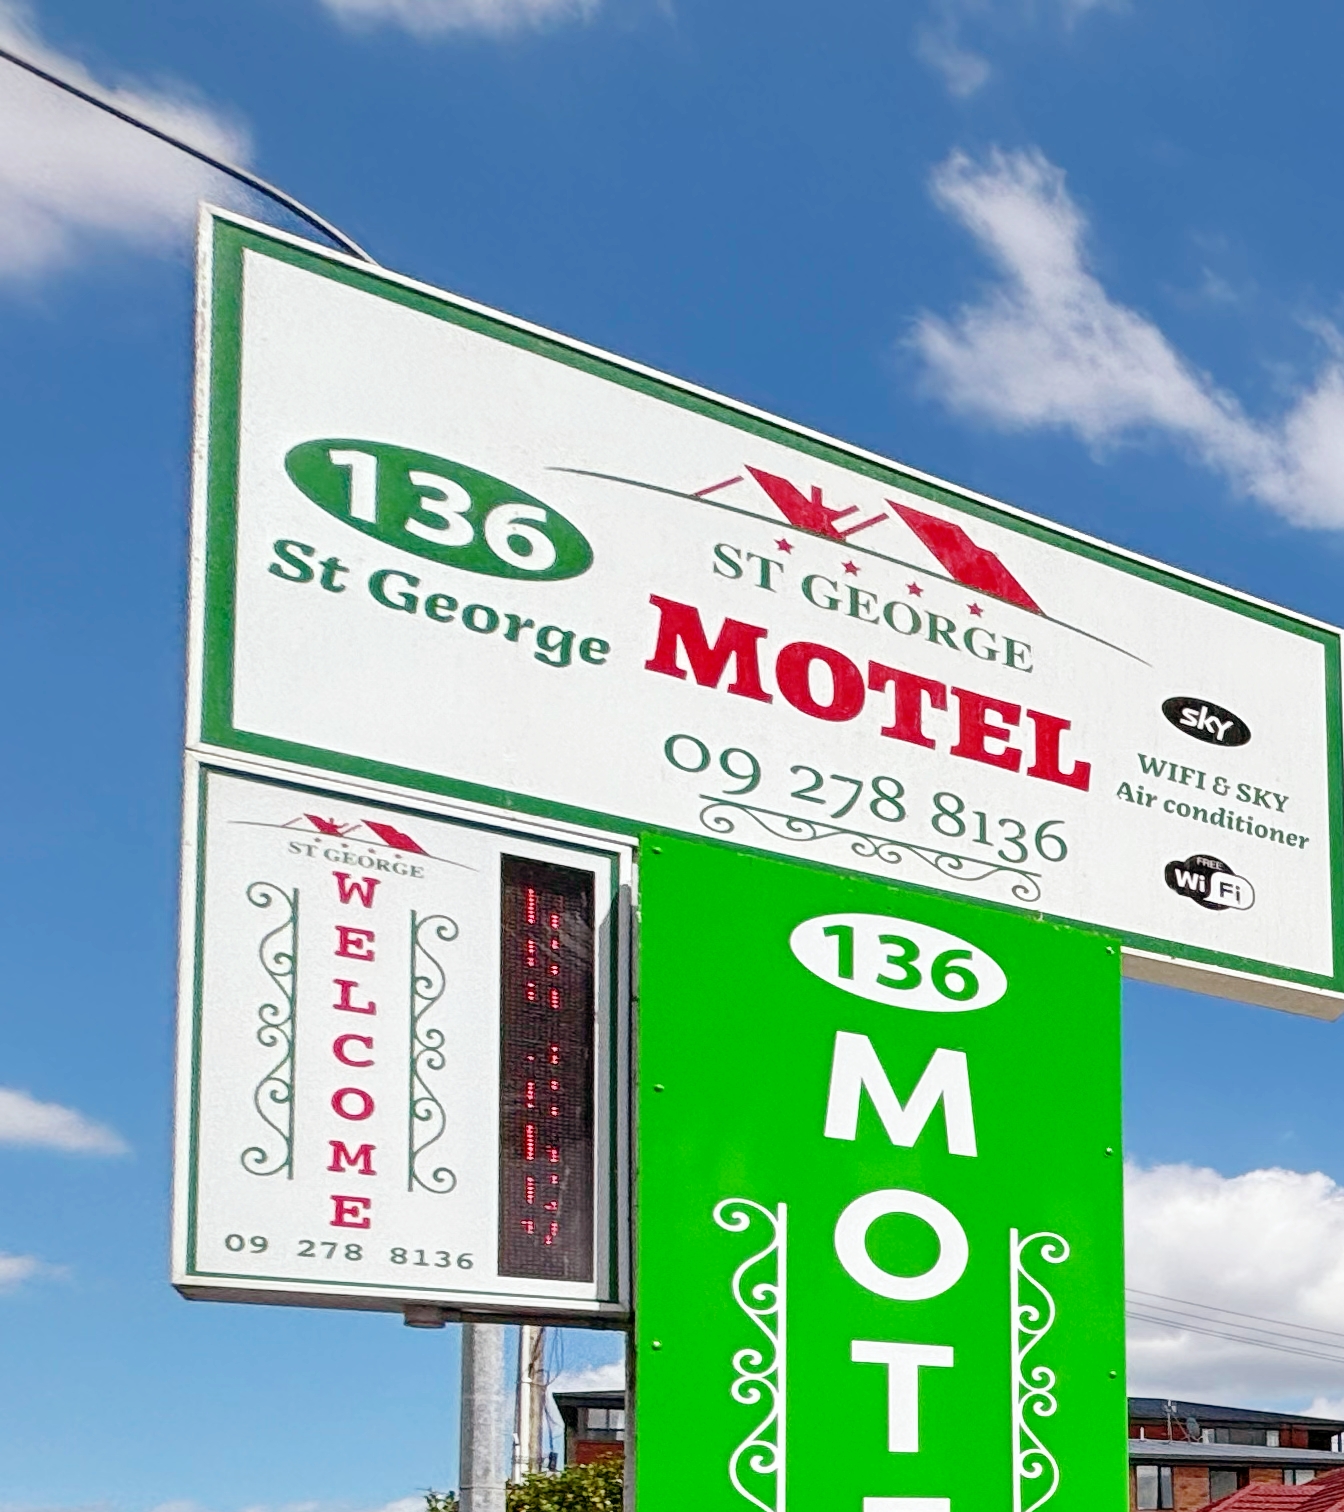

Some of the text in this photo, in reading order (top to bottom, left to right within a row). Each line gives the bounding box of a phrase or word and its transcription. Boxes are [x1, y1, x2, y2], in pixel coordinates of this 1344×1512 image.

[329, 448, 558, 572] 136
[268, 539, 611, 668] St George
[712, 543, 1034, 674] ST GEORGE
[645, 594, 1091, 793] MOTEL
[664, 733, 1069, 864] 09 278 8136
[1116, 781, 1310, 849] Air conditioner
[1137, 753, 1289, 813] WIFI & SKY
[288, 840, 425, 879] ST GEORGE
[821, 924, 980, 1002] 136
[326, 870, 381, 1231] WELCOME
[224, 1233, 475, 1271] 09 278 8136
